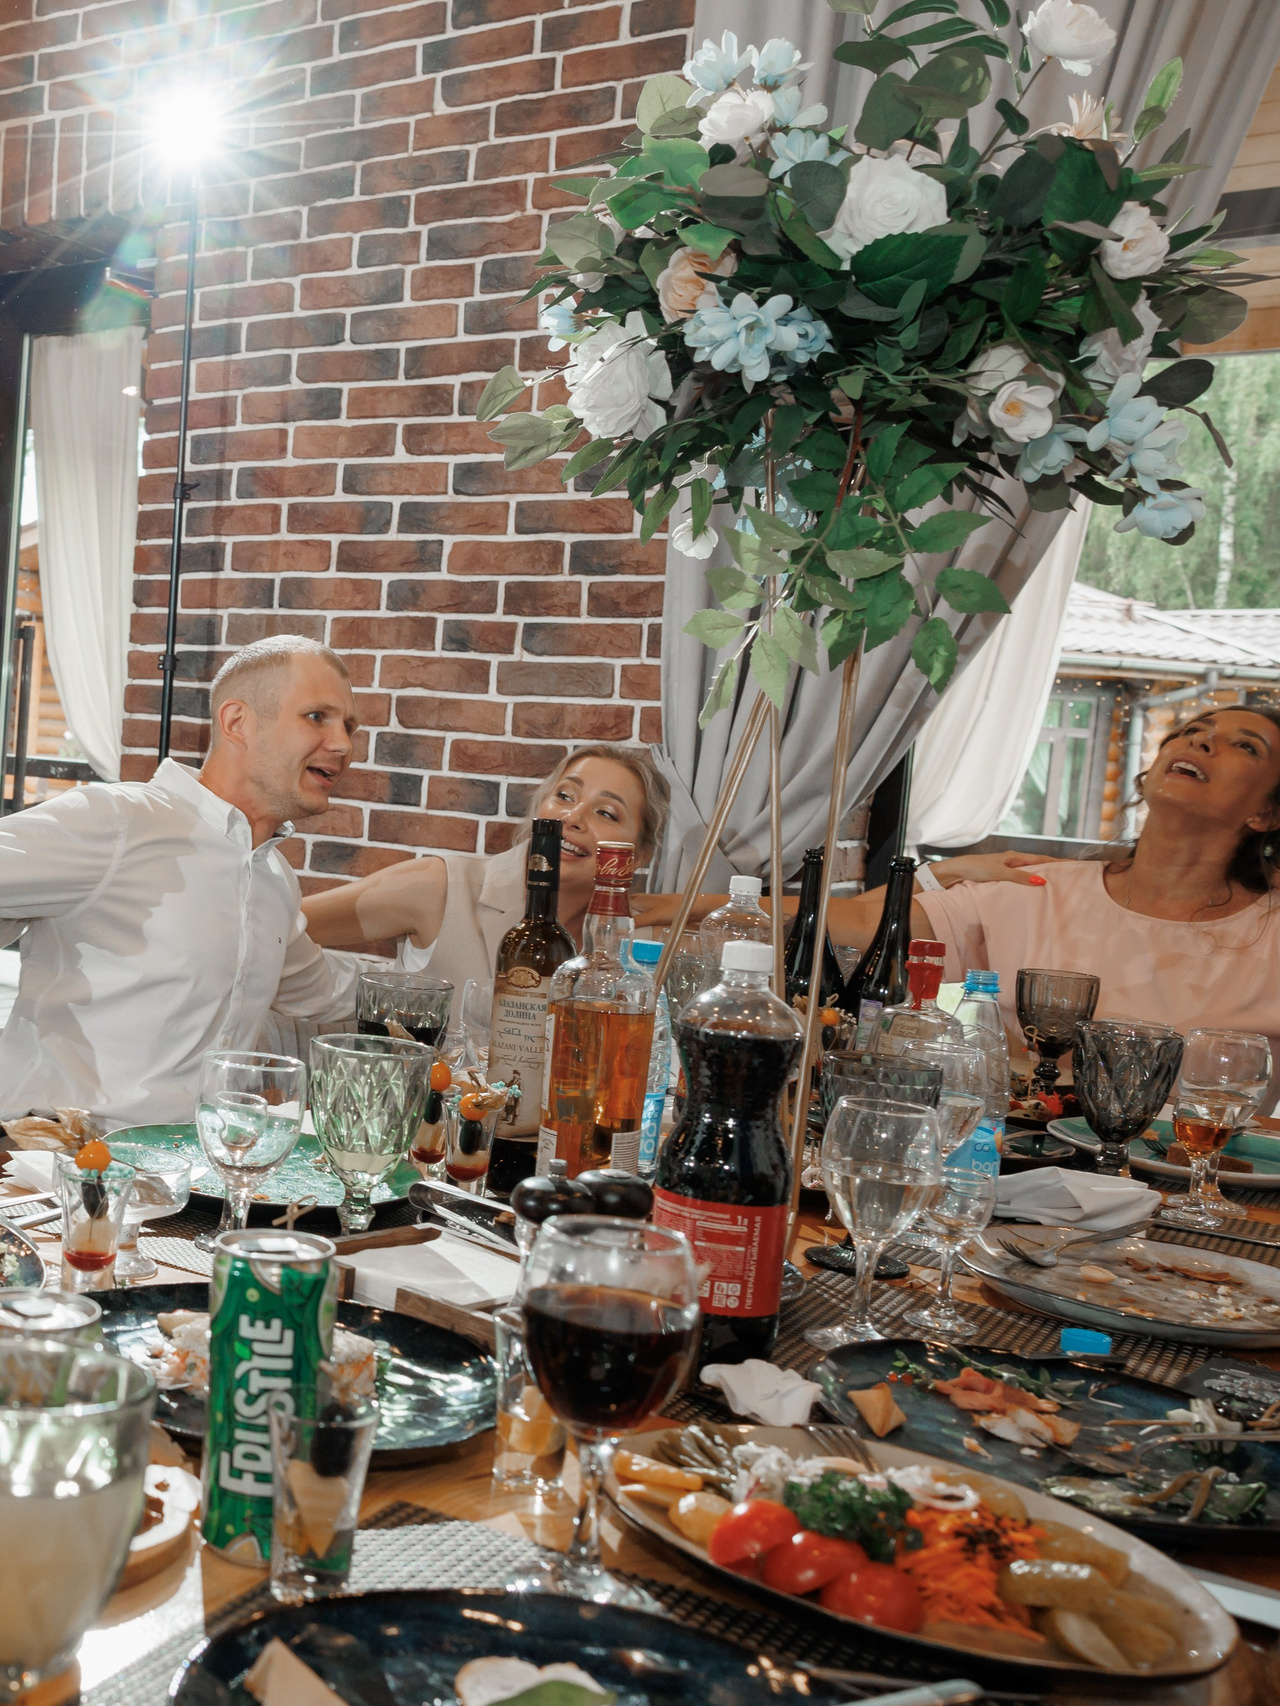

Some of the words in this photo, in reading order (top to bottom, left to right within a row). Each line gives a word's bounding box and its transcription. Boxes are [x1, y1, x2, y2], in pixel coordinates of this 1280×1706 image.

[504, 1009, 536, 1020] ДОЛИНА
[518, 1045, 545, 1054] VALLE
[745, 1216, 762, 1309] ПЕРЕРАБАТЫВАЕМАЯ
